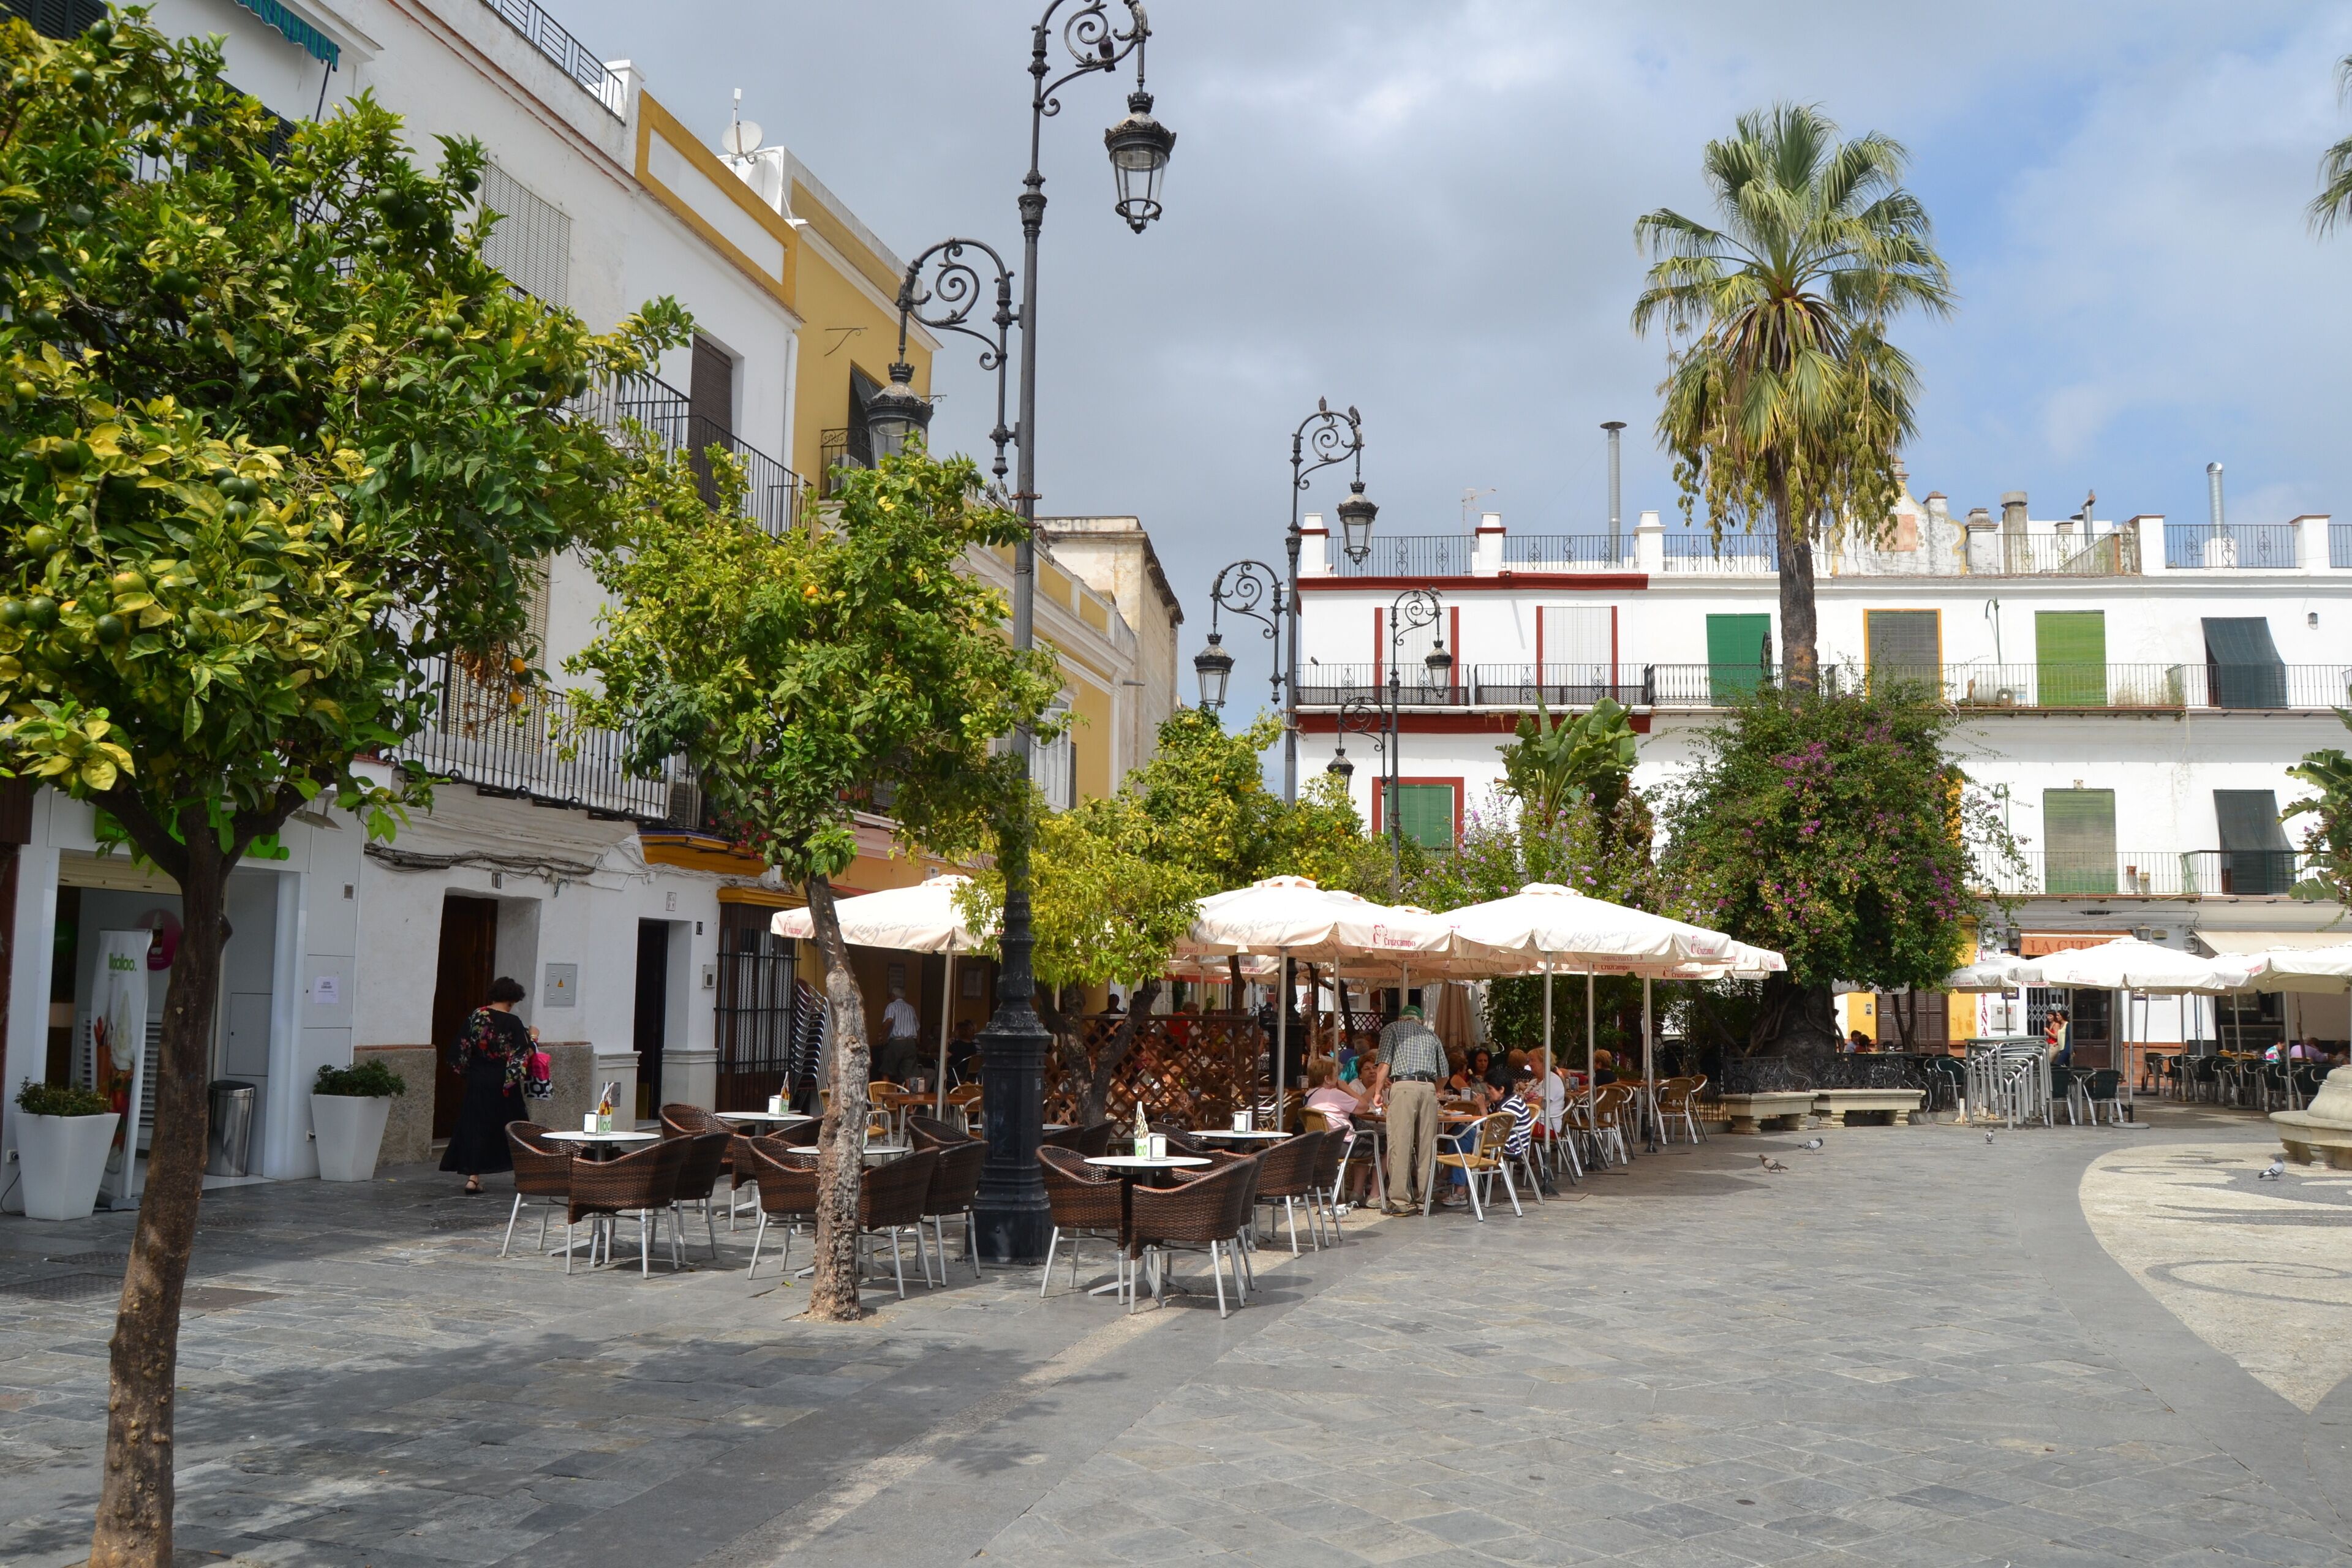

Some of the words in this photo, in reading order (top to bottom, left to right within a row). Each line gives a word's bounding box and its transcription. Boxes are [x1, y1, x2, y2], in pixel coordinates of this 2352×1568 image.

[842, 919, 932, 944] ruzcampo
[1384, 937, 1416, 948] Cruzcampo
[2031, 940, 2051, 953] LA
[2057, 940, 2107, 951] GITA
